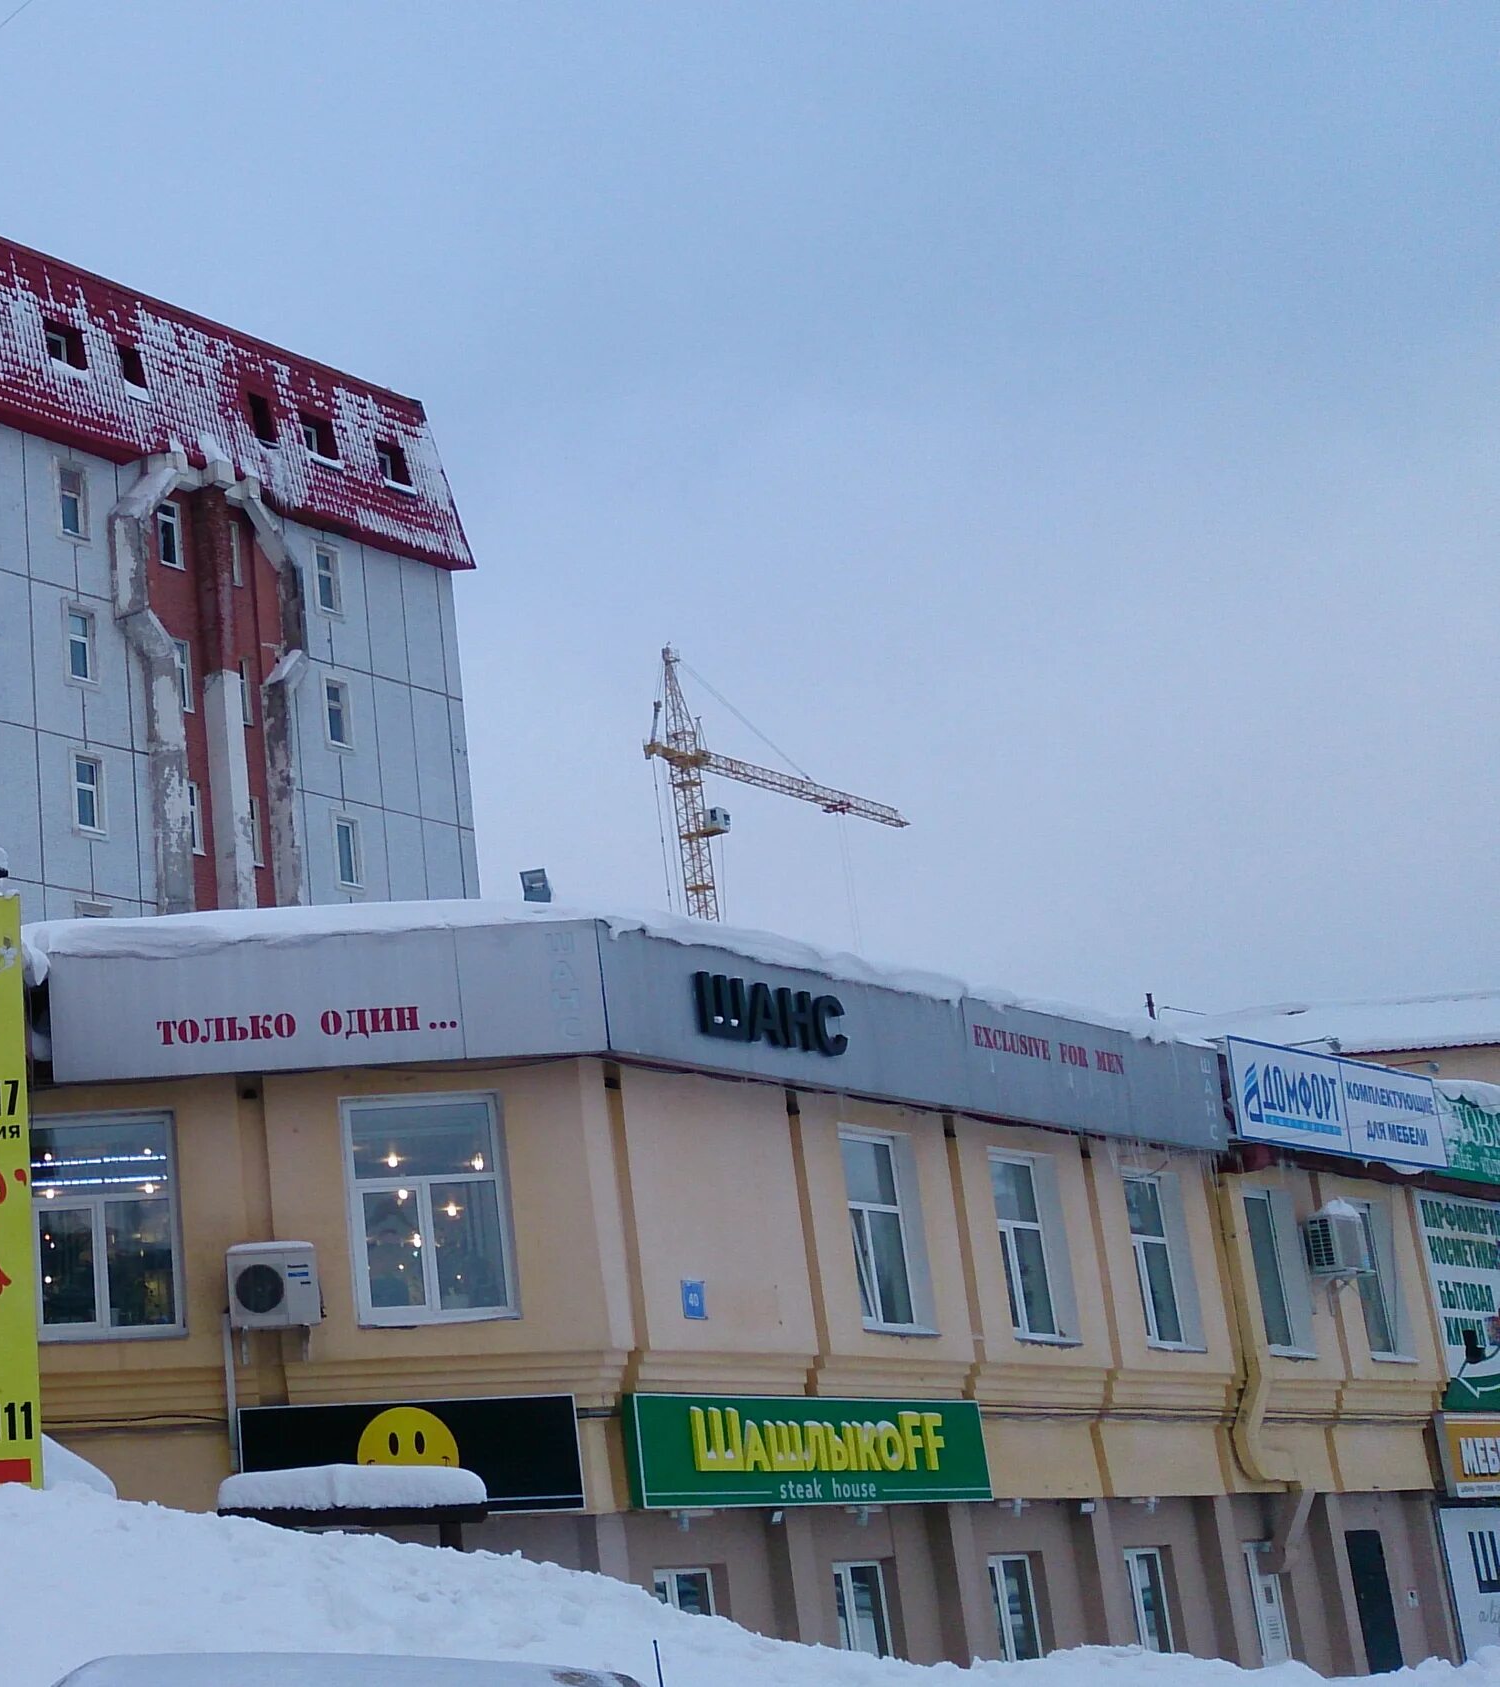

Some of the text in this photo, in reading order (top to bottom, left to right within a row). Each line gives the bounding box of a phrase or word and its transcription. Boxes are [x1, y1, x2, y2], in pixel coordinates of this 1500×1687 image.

[156, 1012, 297, 1046] ТОЛЬКО
[691, 970, 849, 1058] ШАНС
[973, 1024, 1124, 1075] EXCLUSIVE FOR MEN
[1200, 1058, 1219, 1141] ШАНС
[1263, 1064, 1339, 1121] ДОМФОРТ
[1345, 1081, 1436, 1115] КОМПЛЕКТУЮЩИЕ
[1367, 1120, 1386, 1141] ДЛЯ
[1388, 1122, 1429, 1146] МЕБЕЛИ
[1437, 1280, 1495, 1312] БЫТОВАЯ
[1460, 1437, 1500, 1475] МЕБ
[780, 1477, 877, 1499] steak house
